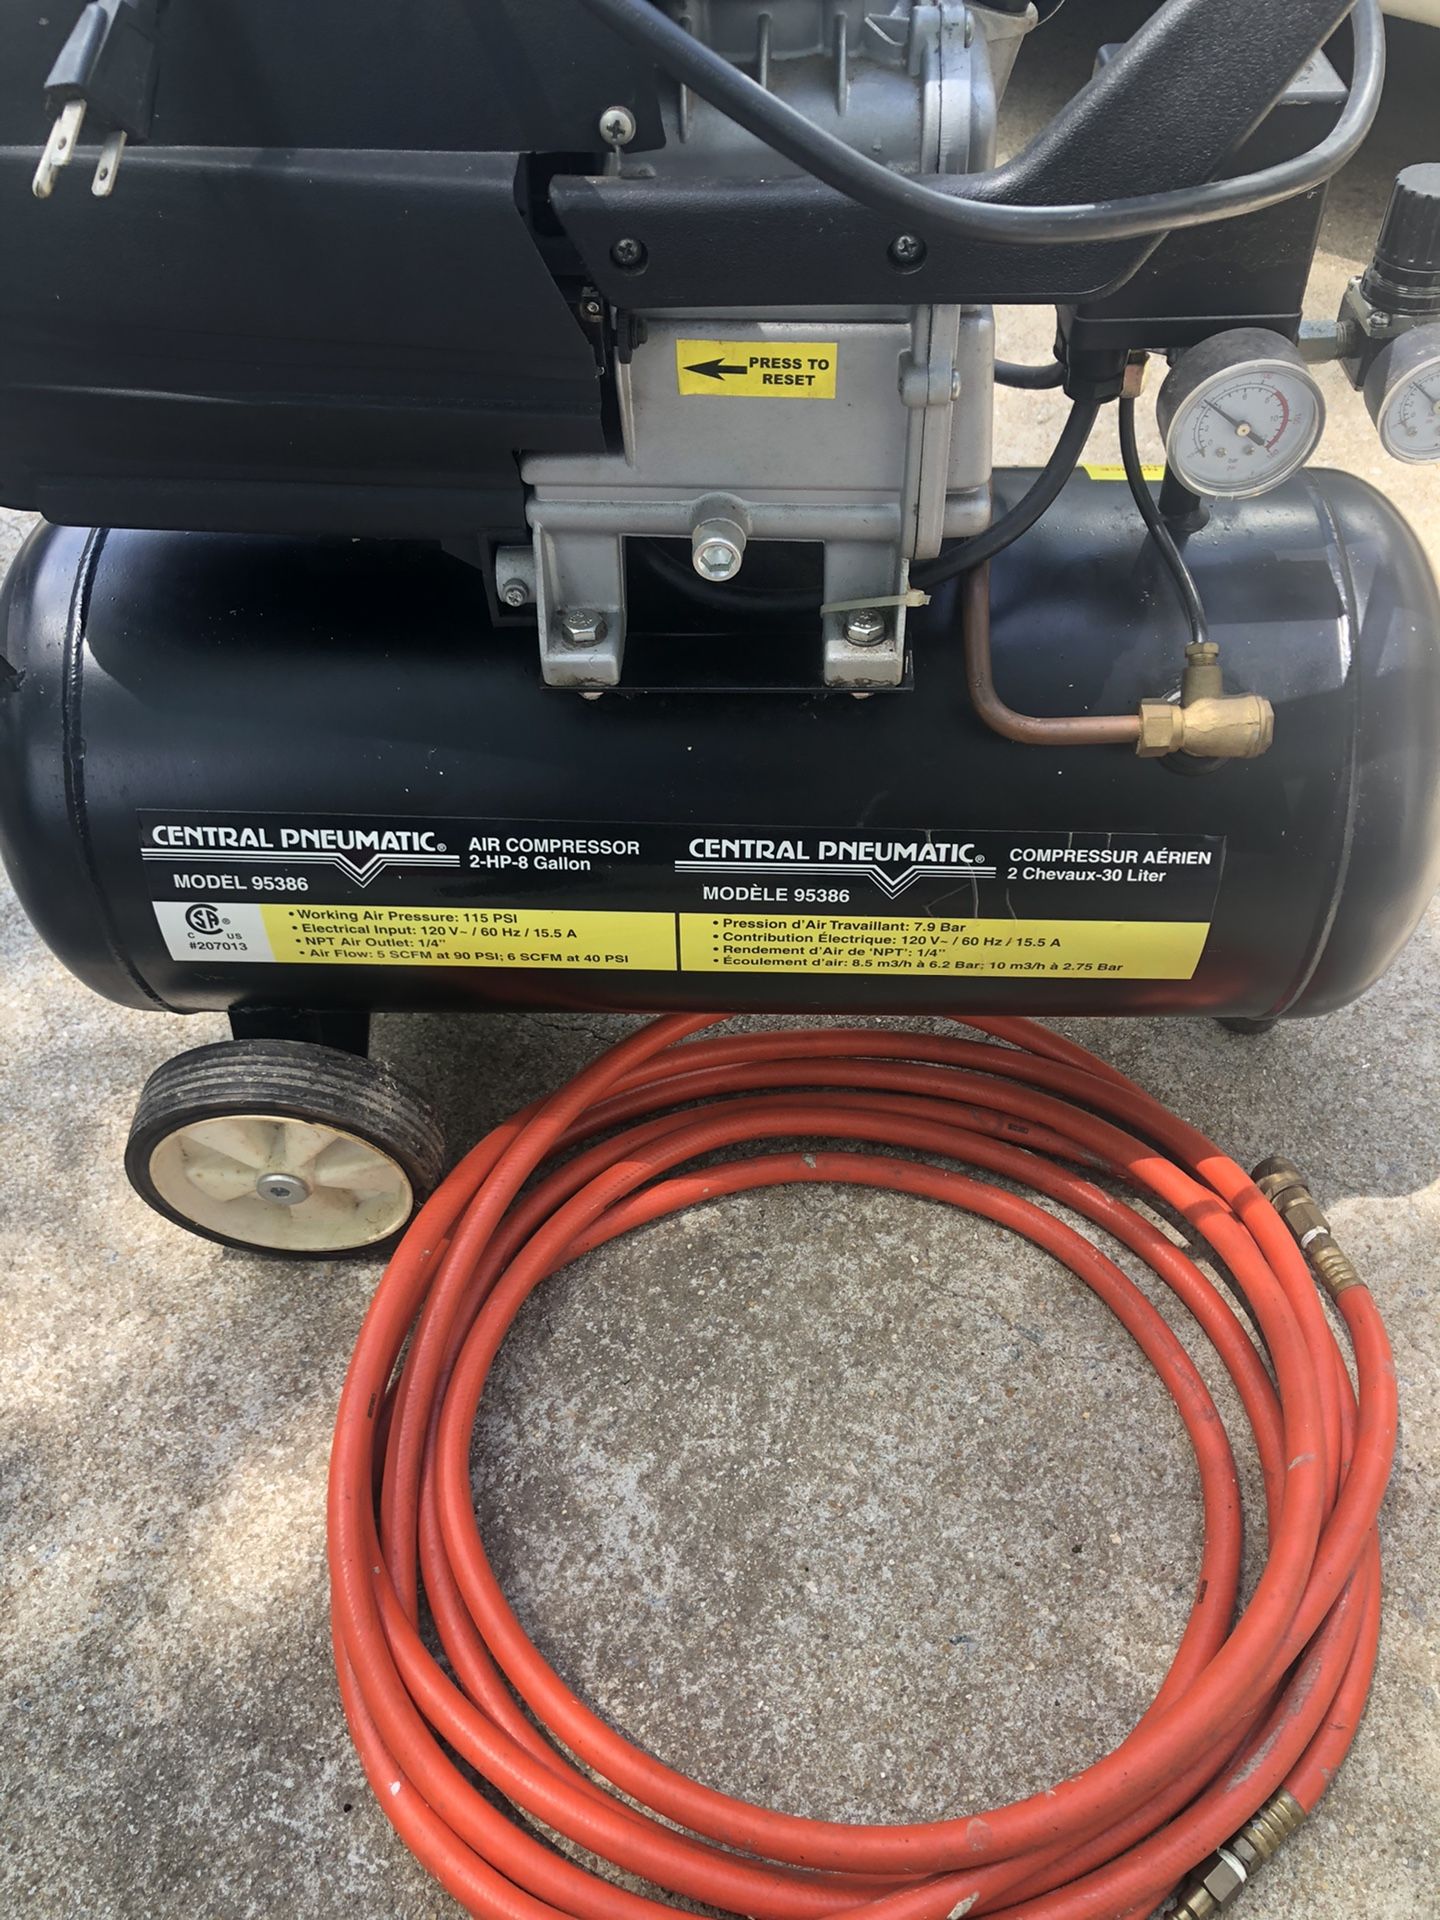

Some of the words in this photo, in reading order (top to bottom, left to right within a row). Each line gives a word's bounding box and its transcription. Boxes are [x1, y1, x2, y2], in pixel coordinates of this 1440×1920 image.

[749, 357, 802, 369] PRESS
[808, 359, 830, 370] TO
[762, 374, 815, 386] RESET
[152, 825, 274, 848] CENTRAL
[468, 837, 500, 851] AIR
[505, 838, 640, 854] COMPRESSOR
[688, 838, 810, 860] CENTRAL
[469, 855, 529, 869] 2-HP-8
[534, 856, 590, 870] Gallon
[1009, 848, 1138, 864] COMPRESSUR
[1142, 848, 1212, 864] AÉRIEN
[1007, 867, 1018, 879] 2
[1022, 868, 1122, 882] Chevaux-30
[1127, 868, 1166, 882] Liter
[174, 874, 247, 890] MODEL
[252, 876, 309, 892] 95386
[703, 883, 788, 902] MODÈLE
[794, 888, 850, 903] 95386
[297, 909, 358, 922] Working
[363, 910, 384, 922] Air
[388, 911, 458, 924] Pressure:
[464, 914, 488, 924] 115
[494, 914, 518, 924] PSI
[302, 924, 370, 935] Electrical
[374, 926, 417, 938] Input:
[421, 926, 446, 936] 120
[480, 928, 498, 937] 60
[502, 928, 522, 938] Hz
[534, 928, 562, 938] 15.5
[566, 929, 577, 938] A
[723, 918, 787, 930] Pression
[830, 920, 910, 932] Travaillant:
[914, 922, 936, 932] 7.9
[940, 922, 966, 932] Bar
[189, 942, 248, 951] #207013
[306, 936, 336, 946] NPT
[340, 936, 362, 946] Air
[365, 938, 414, 948] Outlet:
[723, 932, 813, 944] Contribution
[818, 932, 896, 946] Électrique:
[902, 936, 927, 945] 120
[962, 936, 979, 946] 60
[984, 937, 1002, 946] Hz
[1016, 937, 1046, 947] 15.5
[1050, 938, 1061, 948] A
[310, 949, 331, 958] Air
[335, 950, 373, 958] Flow:
[378, 950, 386, 958] 5
[390, 950, 432, 960] SCFM
[437, 952, 450, 960] at
[454, 952, 470, 960] 90
[507, 952, 516, 961] 6
[520, 953, 562, 962] SCFM
[566, 954, 580, 962] at
[584, 954, 601, 963] 40
[605, 954, 628, 963] PSI
[723, 945, 805, 955] Rendement
[847, 946, 866, 956] de
[723, 955, 808, 966] Écoulement
[852, 959, 872, 968] 8.5
[877, 959, 912, 968] m3/h
[916, 958, 925, 969] à
[929, 960, 950, 969] 6.2
[990, 961, 1006, 970] 10
[1010, 962, 1045, 970] m3/h
[1050, 960, 1058, 971] à
[1063, 962, 1093, 972] 2.75
[1097, 962, 1123, 972] Bar
